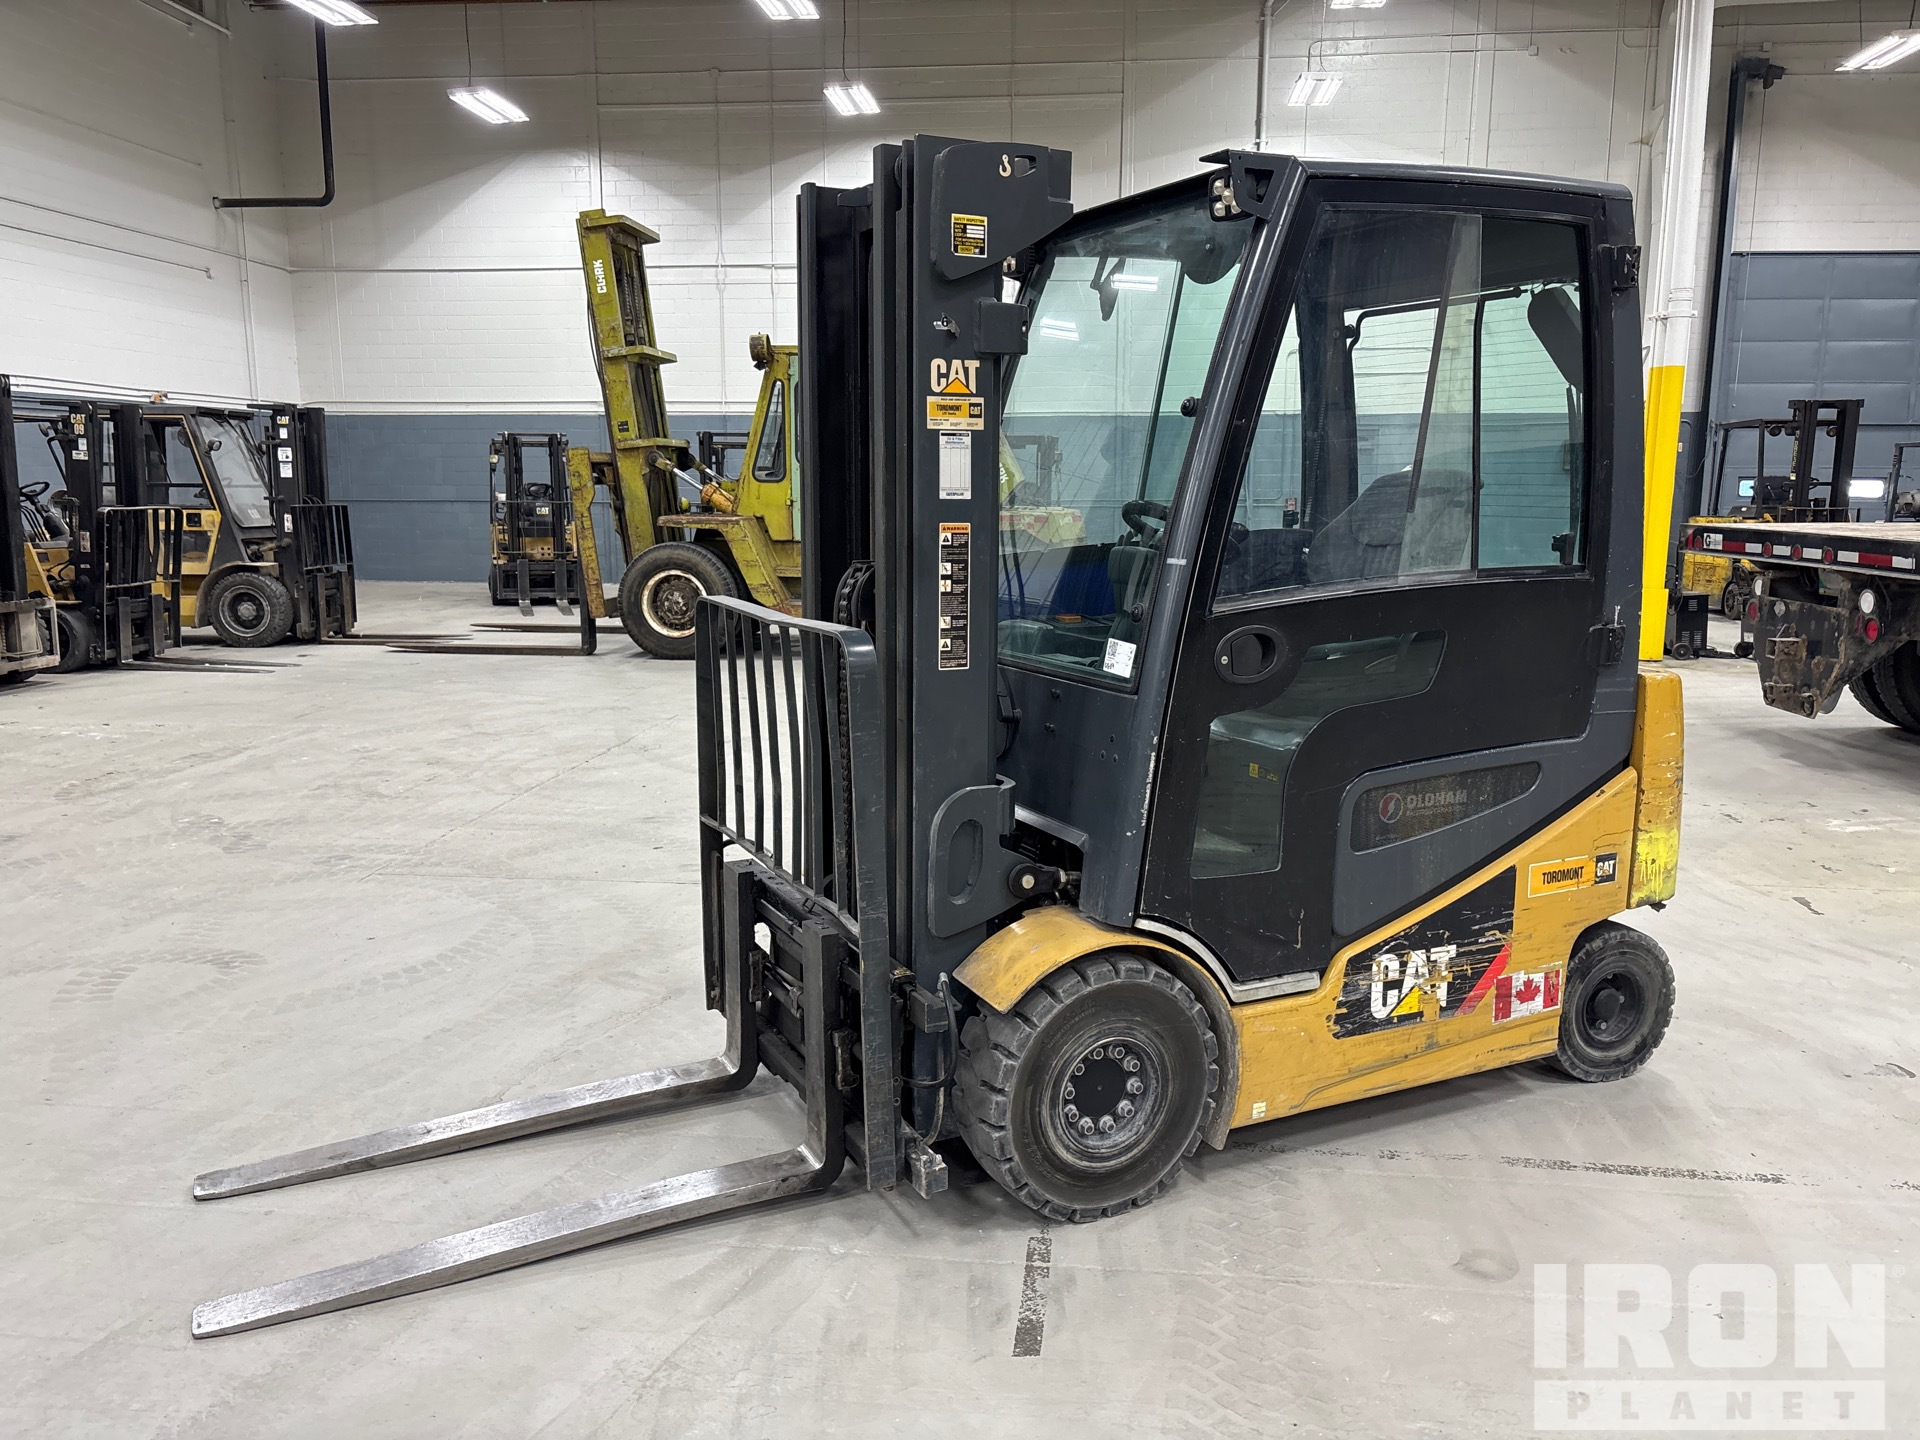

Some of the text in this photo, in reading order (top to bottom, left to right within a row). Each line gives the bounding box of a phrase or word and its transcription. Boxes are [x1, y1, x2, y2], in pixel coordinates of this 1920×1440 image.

[593, 259, 607, 294] CLARK
[930, 358, 980, 394] CAT
[936, 404, 963, 412] TOROMONT
[970, 406, 981, 415] CAT
[70, 413, 86, 424] CAT
[276, 416, 289, 425] CAT
[74, 423, 85, 435] 09
[536, 507, 550, 515] CAT
[1406, 789, 1468, 808] OLDHAM
[1542, 866, 1584, 885] TOROMONT
[1596, 860, 1615, 877] CAT
[1370, 944, 1457, 1019] CAT
